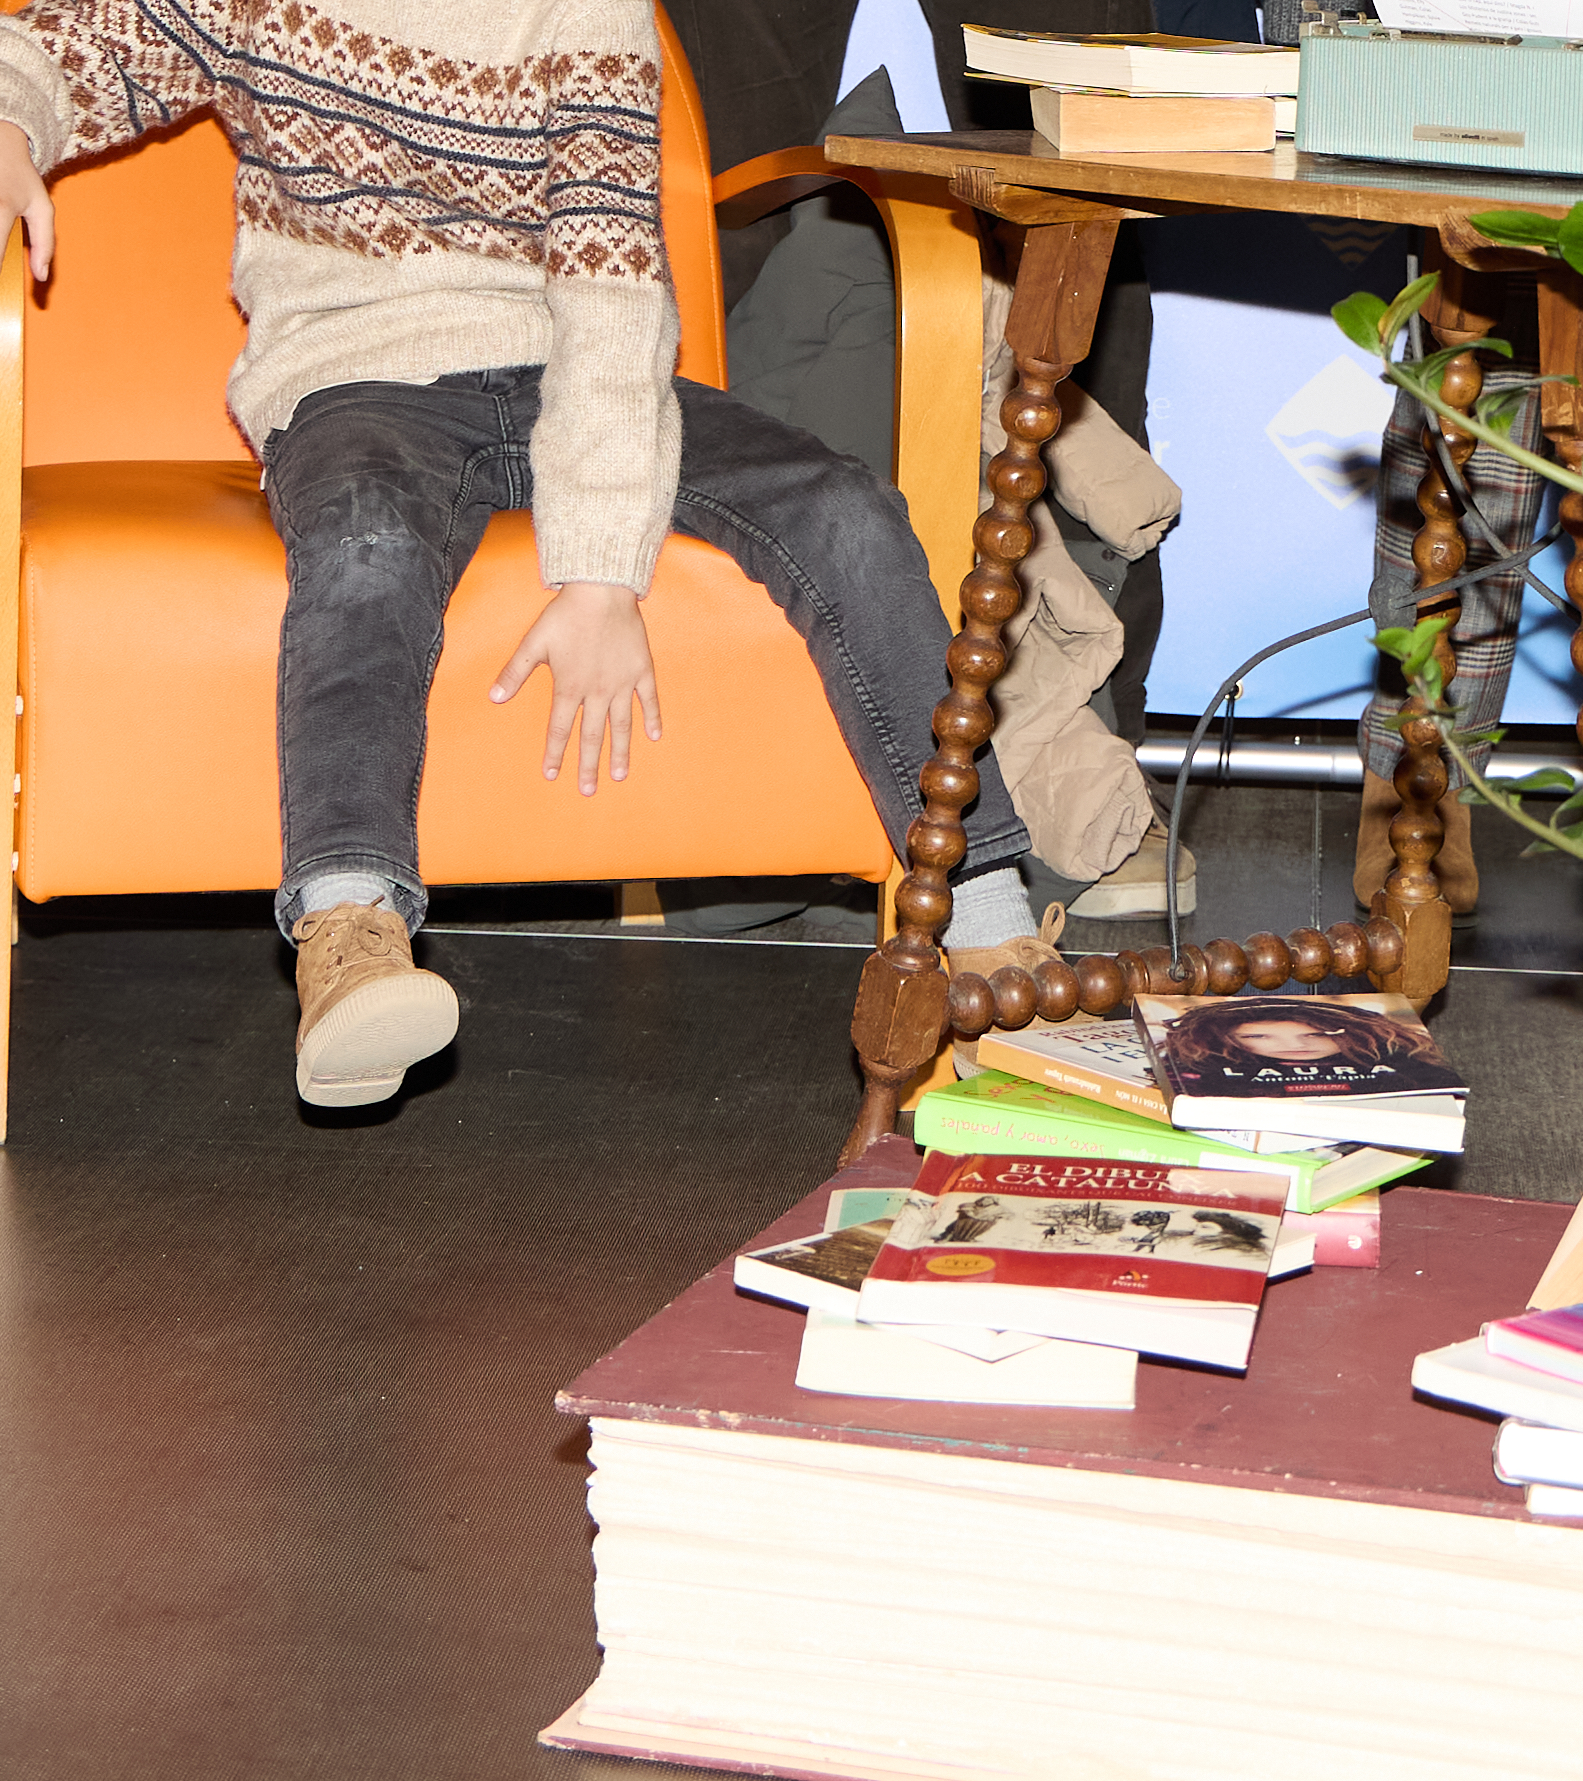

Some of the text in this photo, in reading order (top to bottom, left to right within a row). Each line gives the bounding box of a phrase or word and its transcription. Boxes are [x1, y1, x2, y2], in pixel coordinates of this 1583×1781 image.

[1223, 1064, 1396, 1077] LAURA
[1010, 1163, 1053, 1176] EL
[995, 1174, 1238, 1199] CATALUNYA
